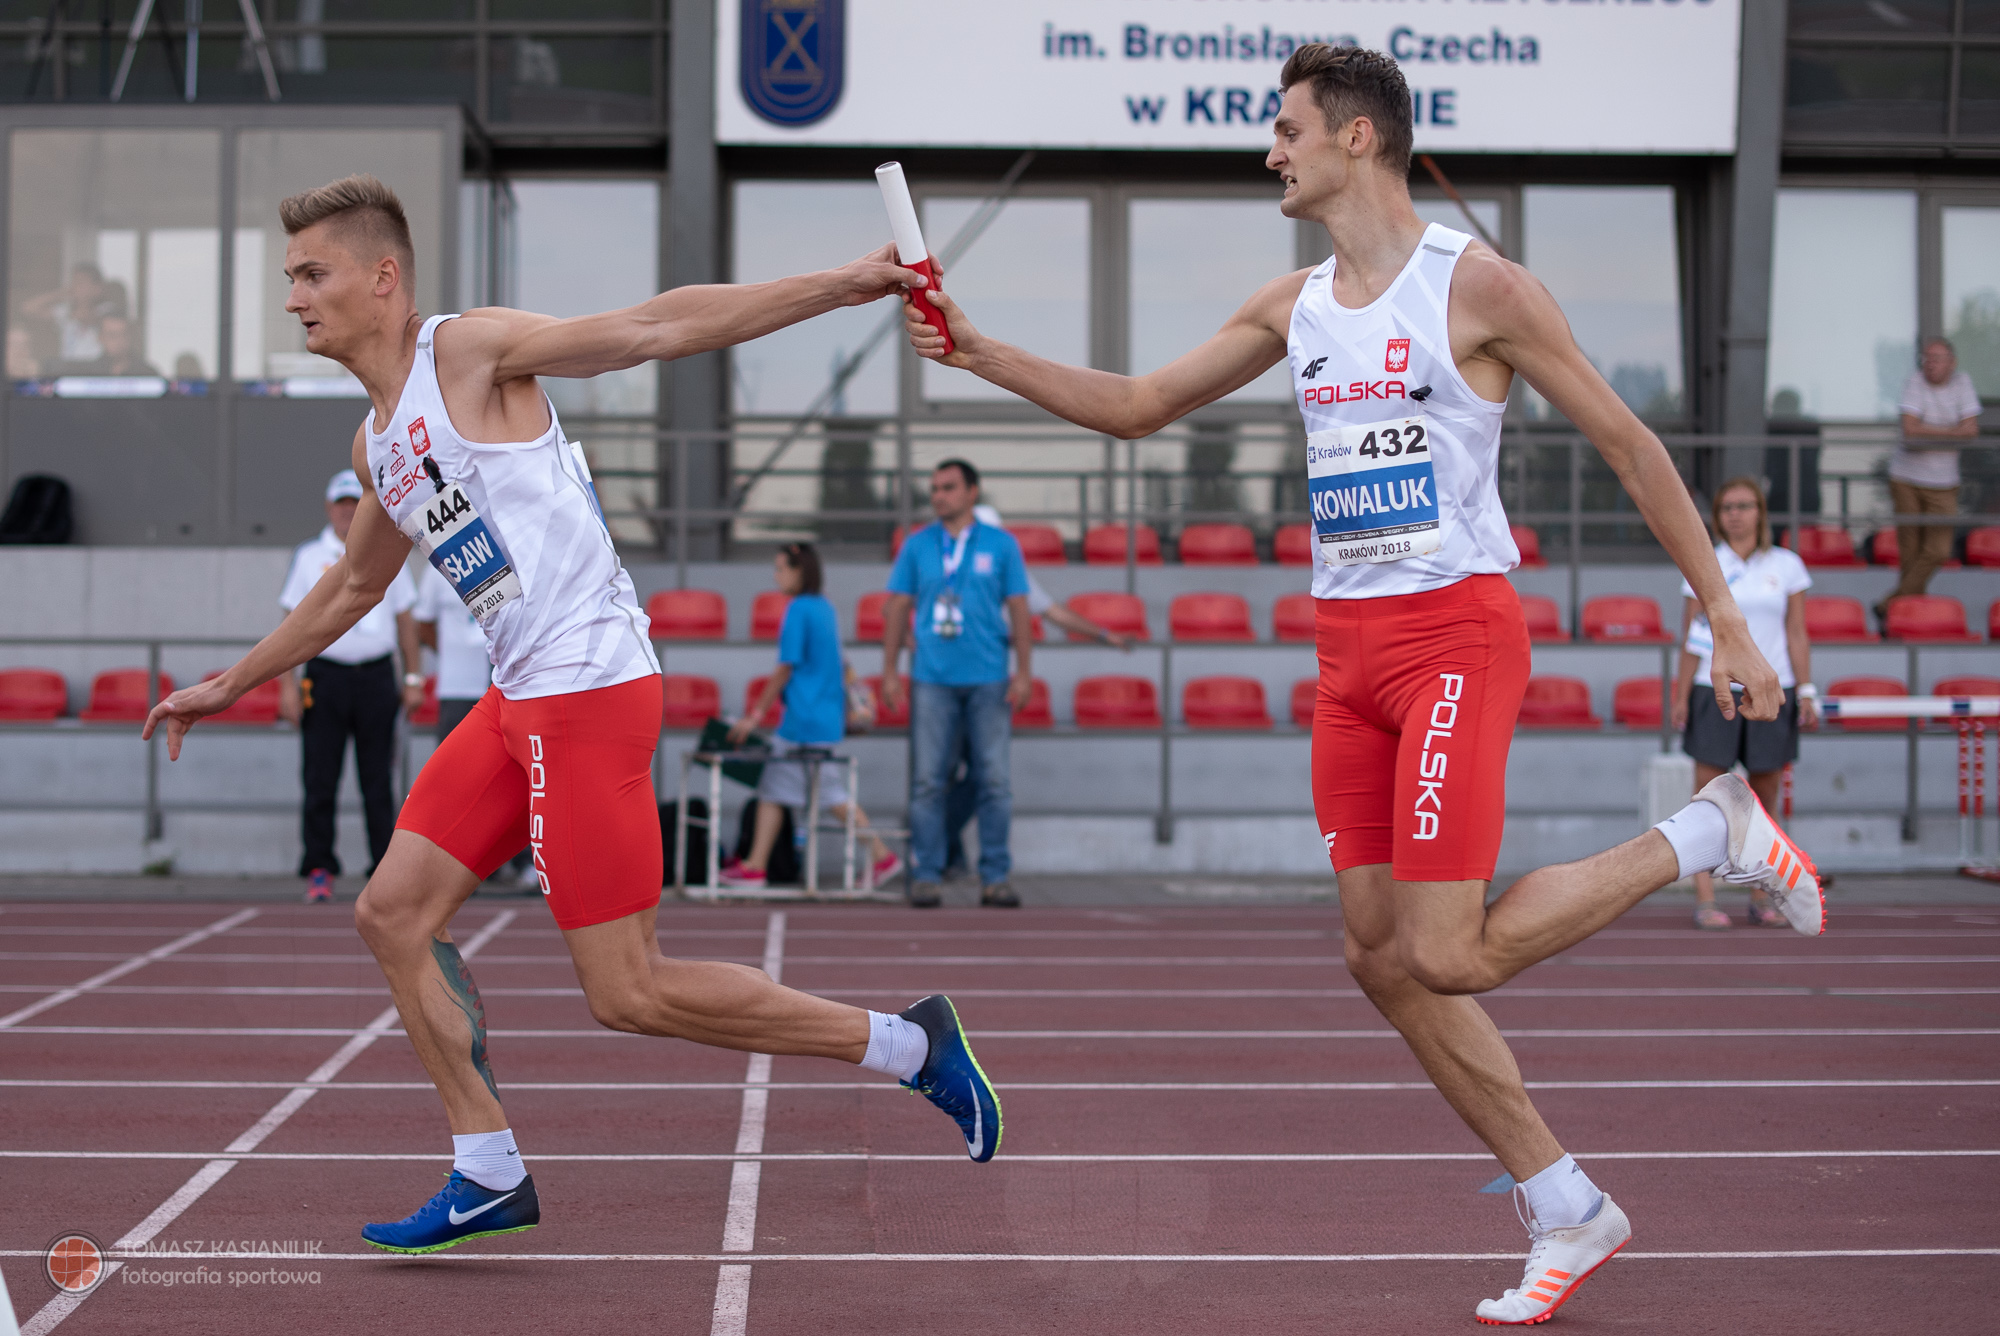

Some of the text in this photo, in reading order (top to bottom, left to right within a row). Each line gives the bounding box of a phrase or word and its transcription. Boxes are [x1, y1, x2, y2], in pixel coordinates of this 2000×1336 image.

[1044, 22, 1106, 58] im.
[1389, 26, 1540, 62] Czecha
[1125, 87, 1457, 125] w KRAIE
[1302, 356, 1329, 380] 4F
[1304, 380, 1406, 407] POLSKA
[1317, 425, 1428, 460] Kraków 432
[426, 488, 472, 534] 444
[1312, 476, 1432, 521] KOWALUK
[1338, 541, 1411, 560] KRAKÓW 2018
[483, 590, 505, 610] 2018
[1412, 673, 1465, 840] POLSKA
